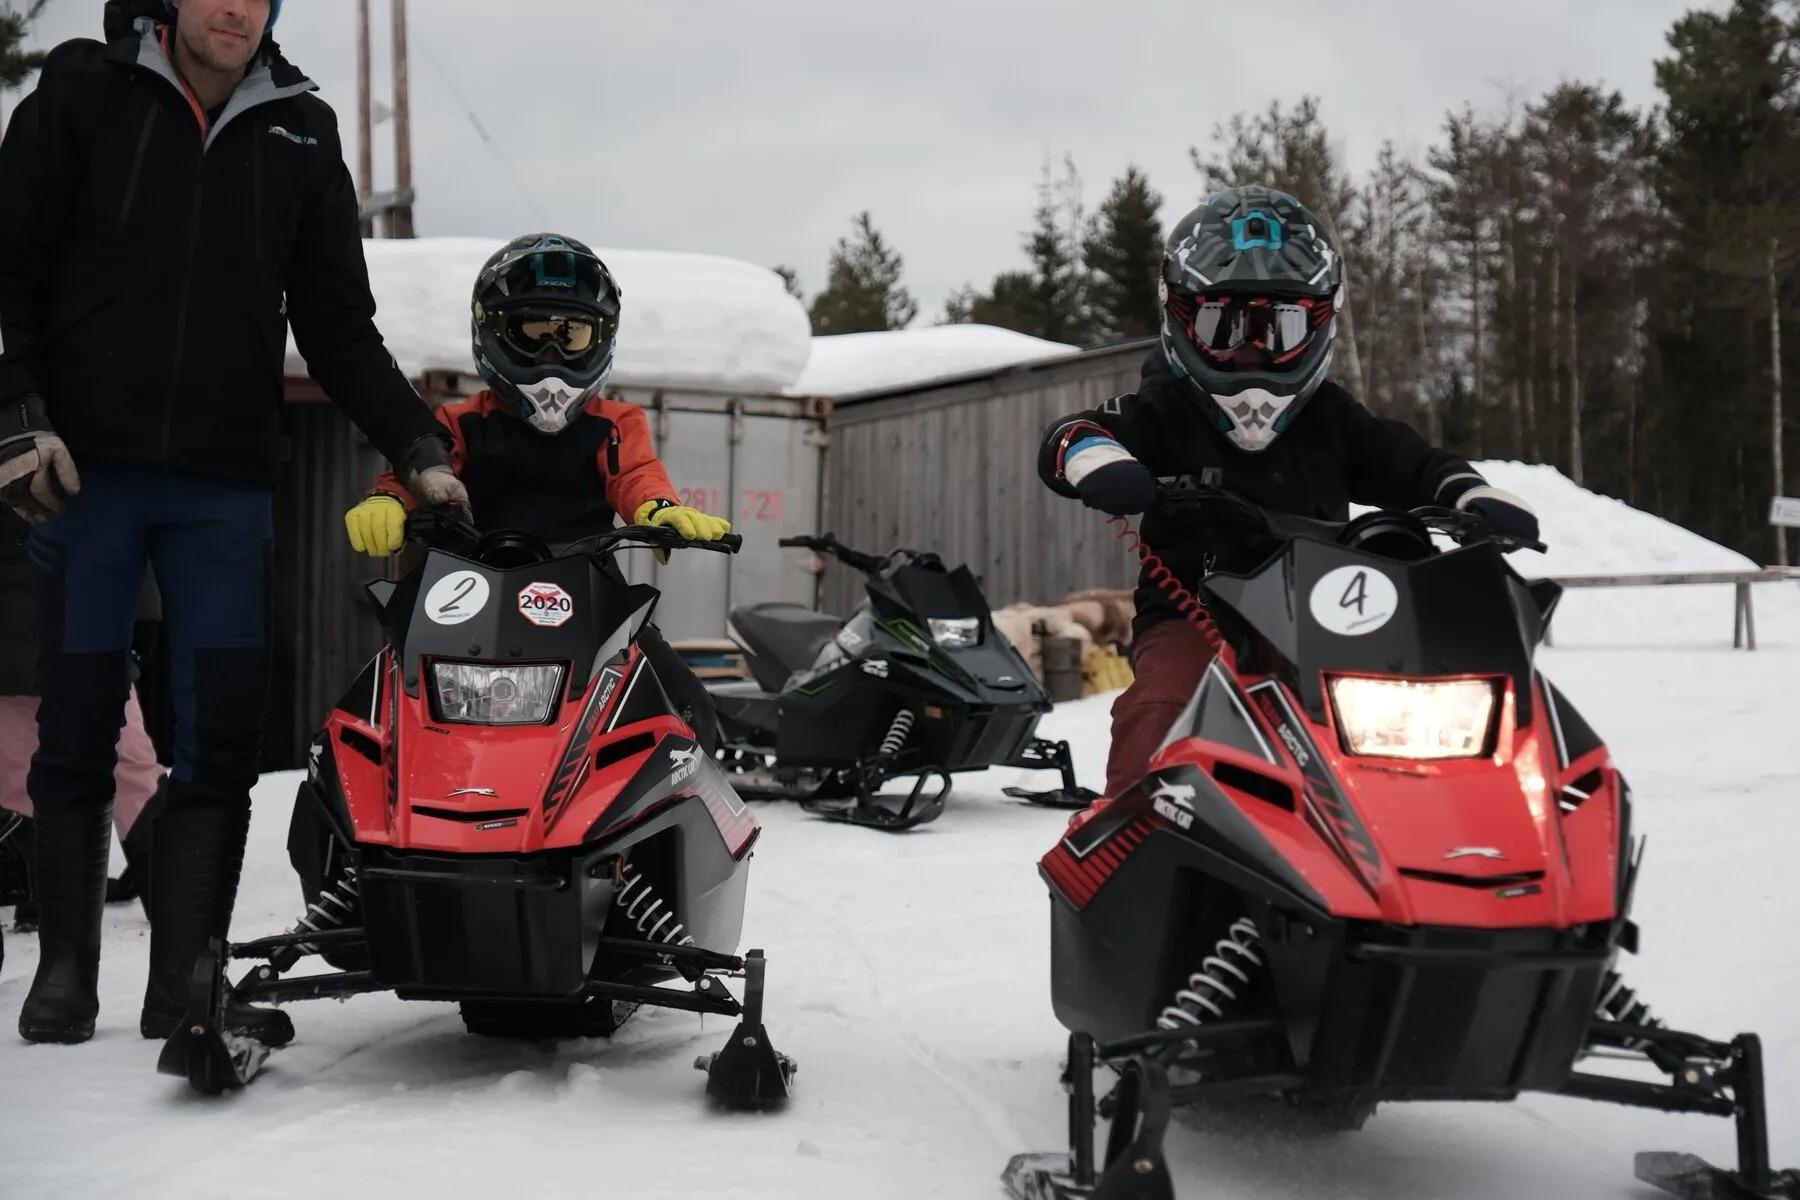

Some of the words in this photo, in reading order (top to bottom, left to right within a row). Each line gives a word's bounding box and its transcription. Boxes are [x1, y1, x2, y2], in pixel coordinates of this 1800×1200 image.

[438, 577, 476, 613] 2
[520, 595, 571, 612] 2020
[1339, 571, 1368, 616] 4
[597, 677, 616, 712] ARCTIC
